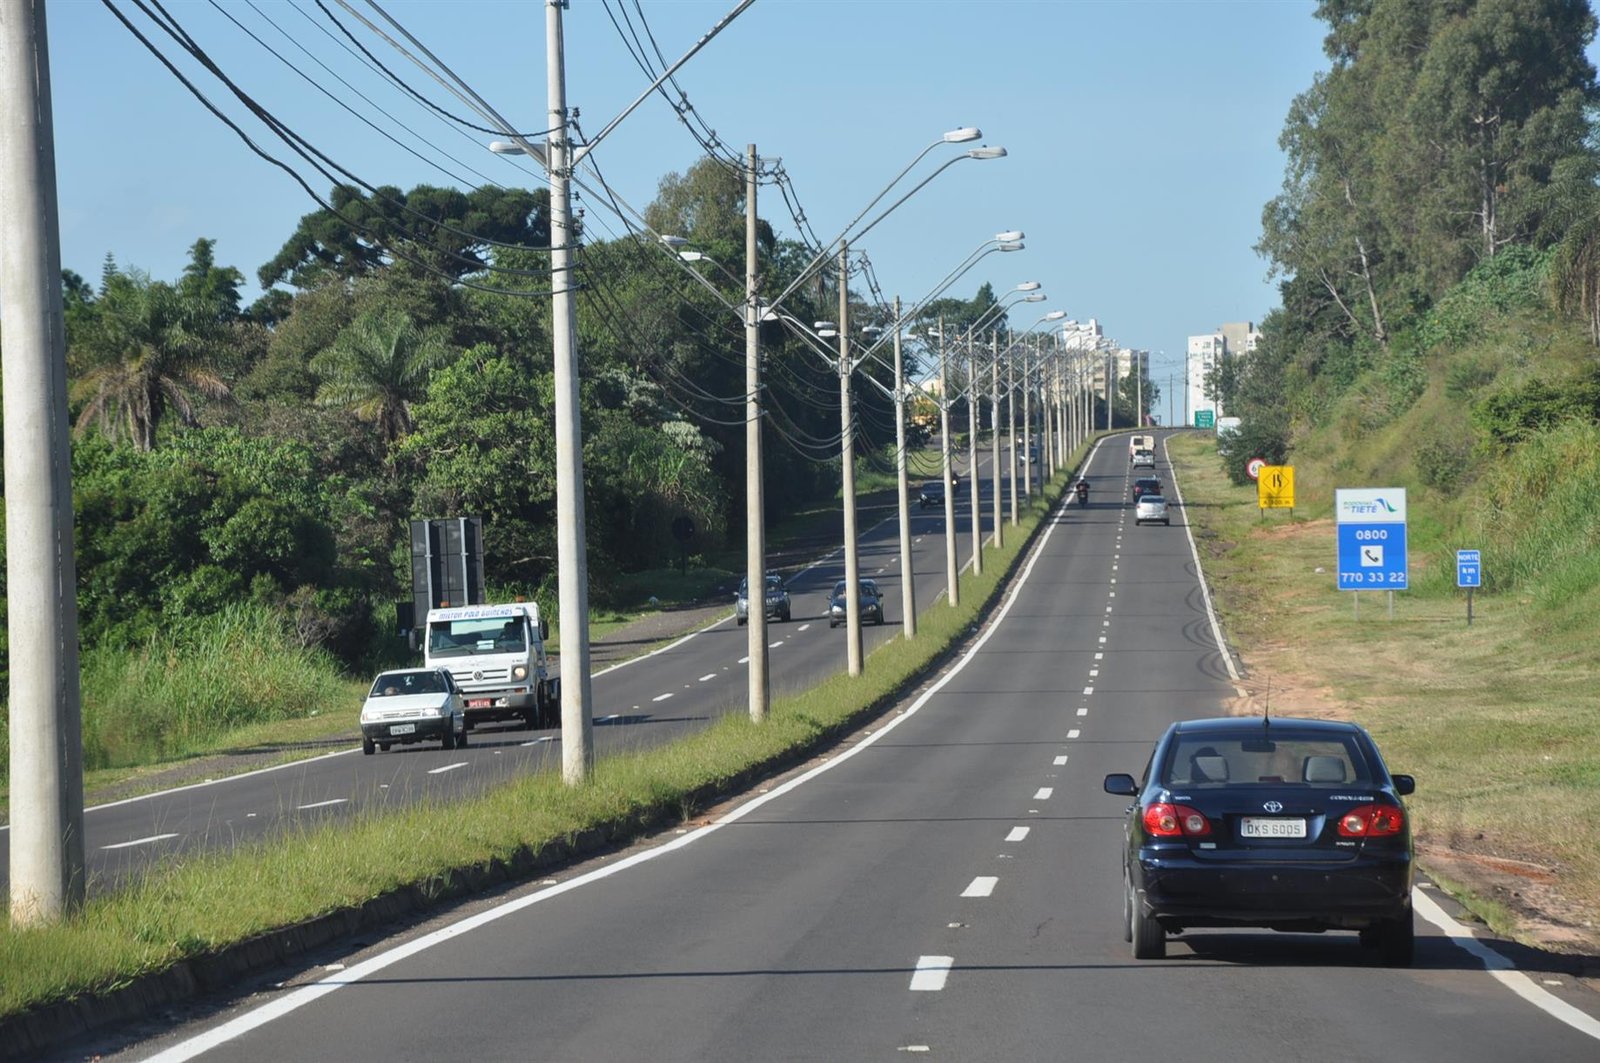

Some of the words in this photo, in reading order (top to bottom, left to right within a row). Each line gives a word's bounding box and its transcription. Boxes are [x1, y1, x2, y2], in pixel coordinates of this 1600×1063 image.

[1355, 529, 1388, 540] 0800
[1341, 572, 1364, 583] 770
[1368, 572, 1384, 583] 33
[1389, 572, 1405, 583] 22
